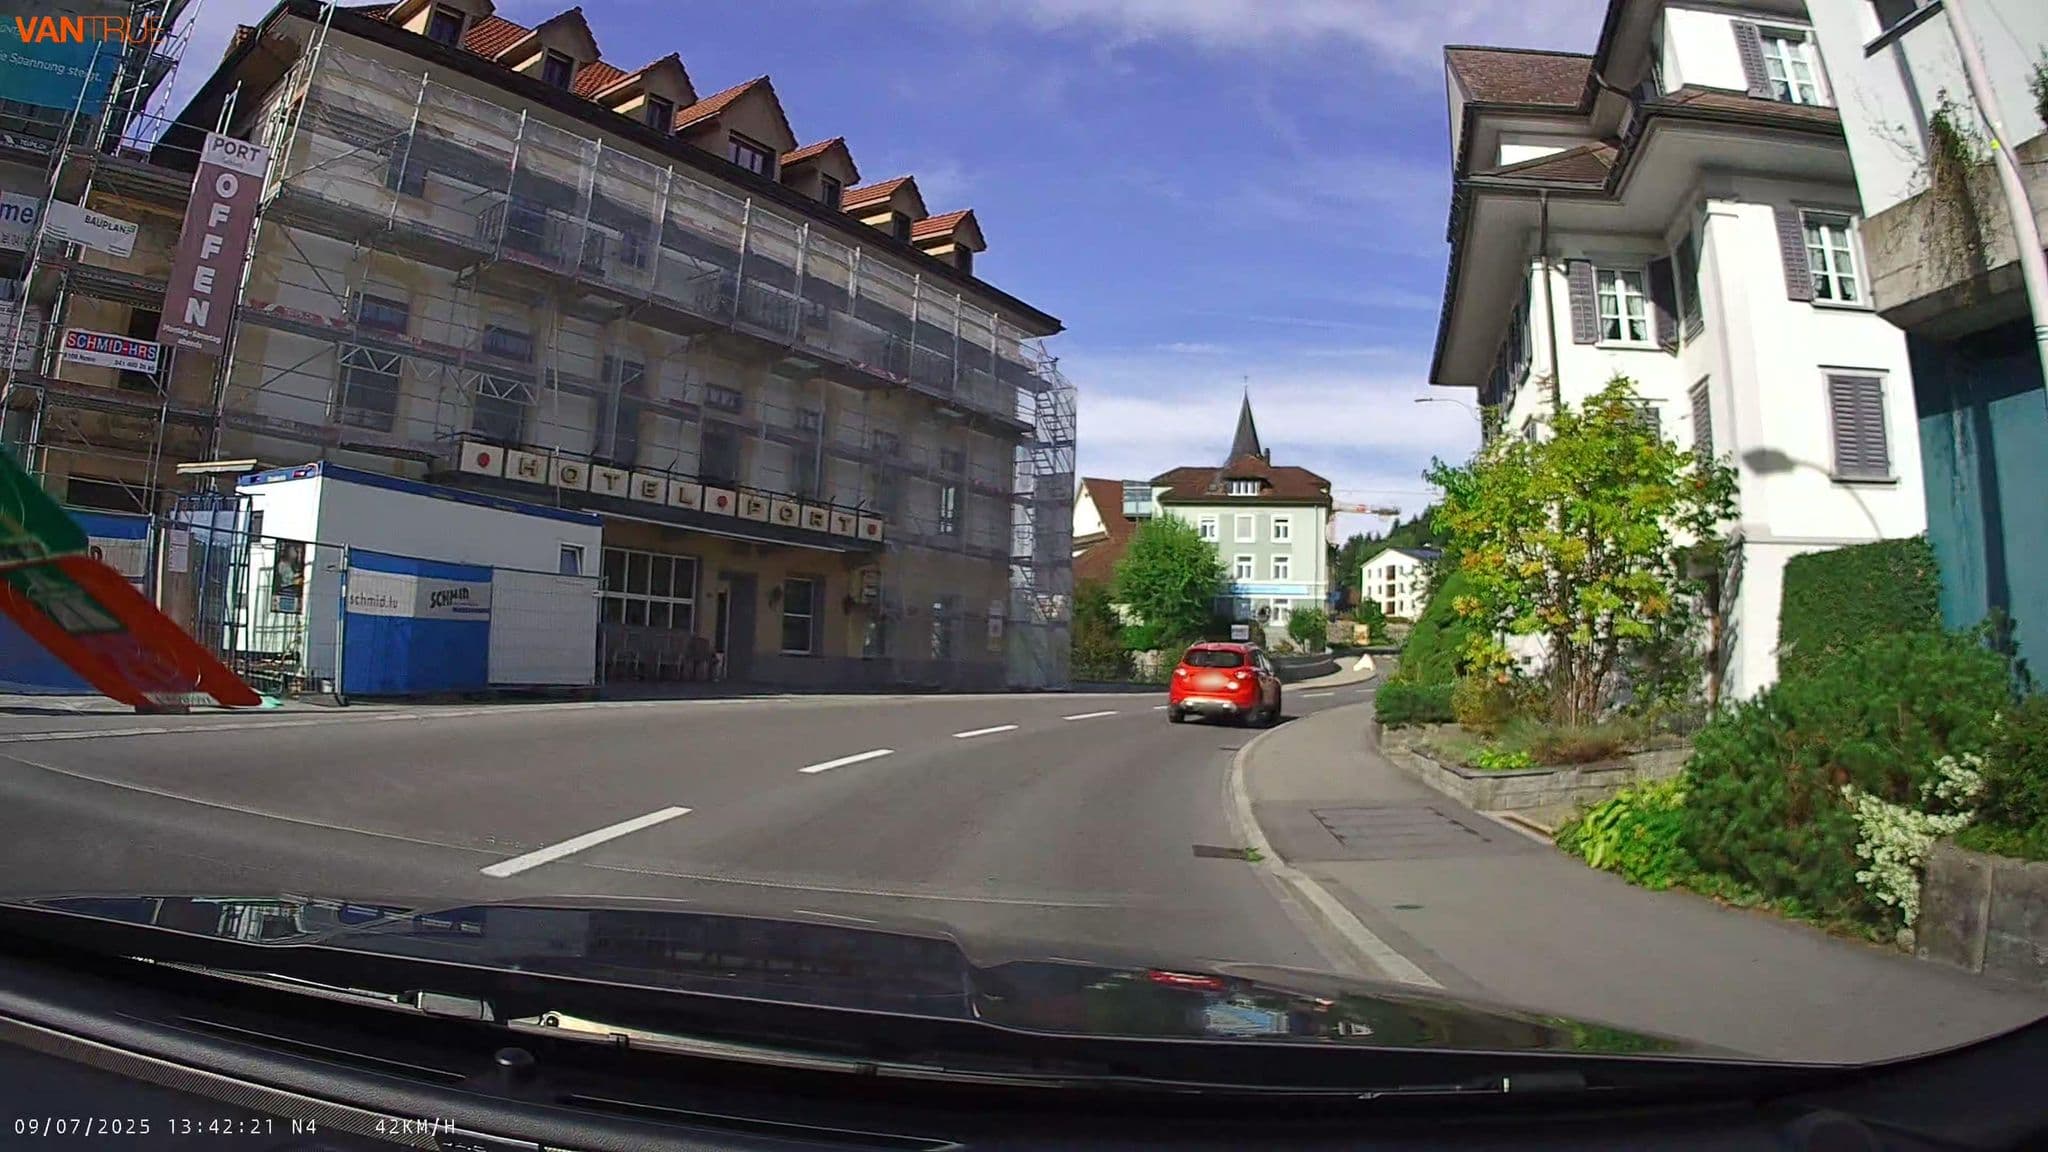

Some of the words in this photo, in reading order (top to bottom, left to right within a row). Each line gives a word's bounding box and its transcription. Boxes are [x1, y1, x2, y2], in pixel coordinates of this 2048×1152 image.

[9, 53, 66, 75] Spannung
[212, 137, 260, 161] PORT
[184, 173, 240, 328] OFFEN
[67, 332, 157, 362] SCHMID-HRS
[518, 456, 692, 506] HOTEL
[747, 498, 852, 532] PORT
[430, 587, 470, 608] SCHMID
